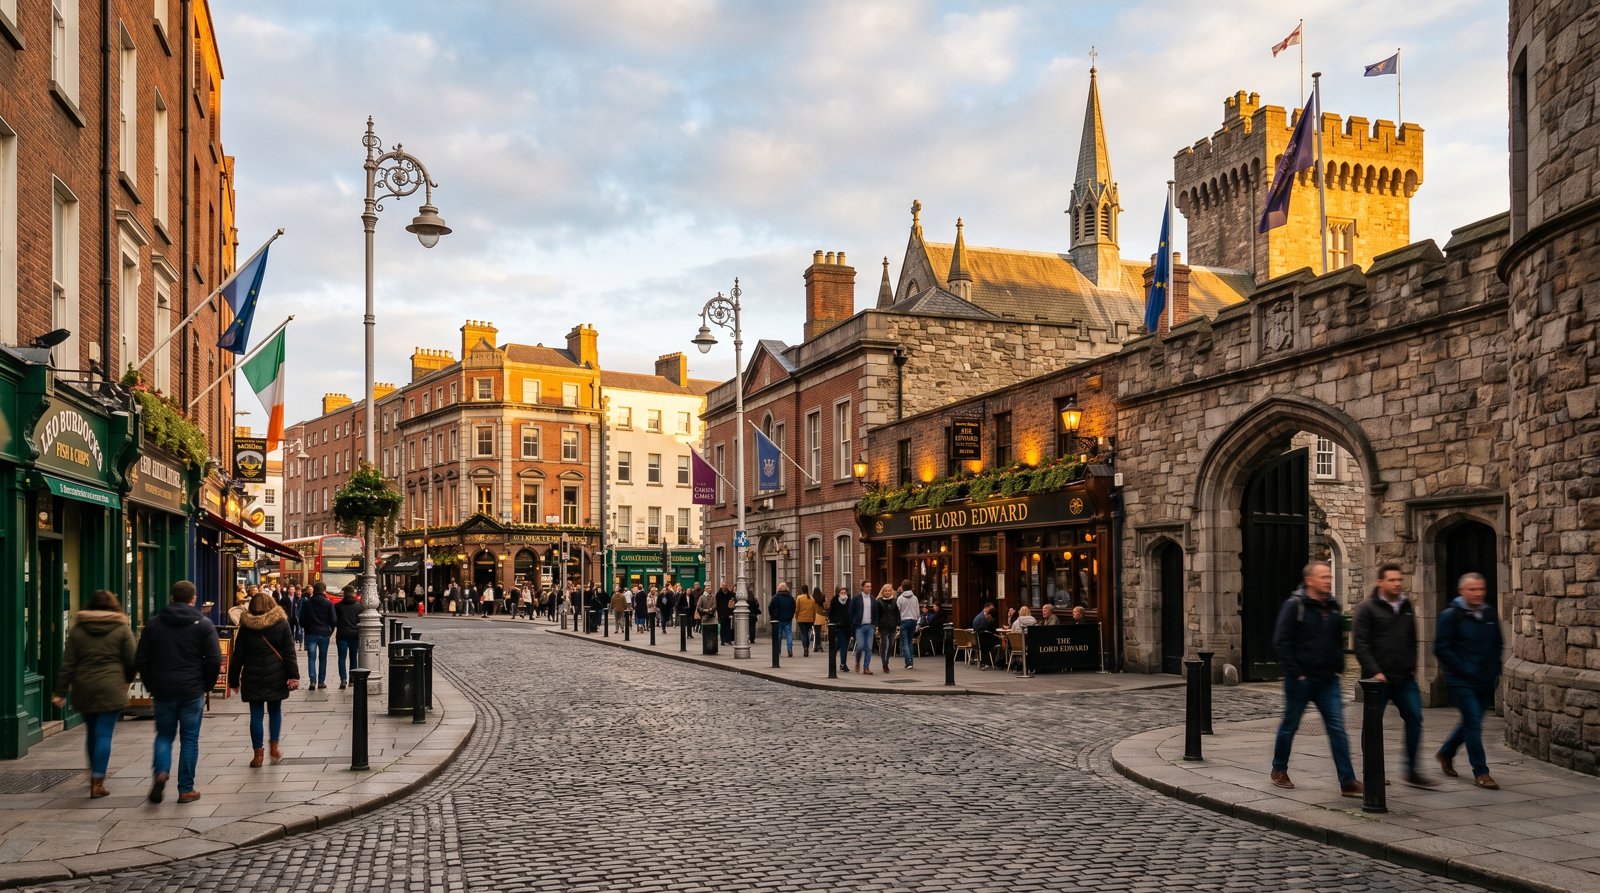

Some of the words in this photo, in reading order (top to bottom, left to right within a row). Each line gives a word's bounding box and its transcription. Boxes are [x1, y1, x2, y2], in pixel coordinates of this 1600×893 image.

[41, 415, 59, 455] LEO
[910, 514, 932, 531] THE
[935, 510, 967, 529] LORD
[971, 503, 1028, 525] EDWARD
[1056, 637, 1071, 645] THE
[1060, 644, 1089, 652] EDWARD
